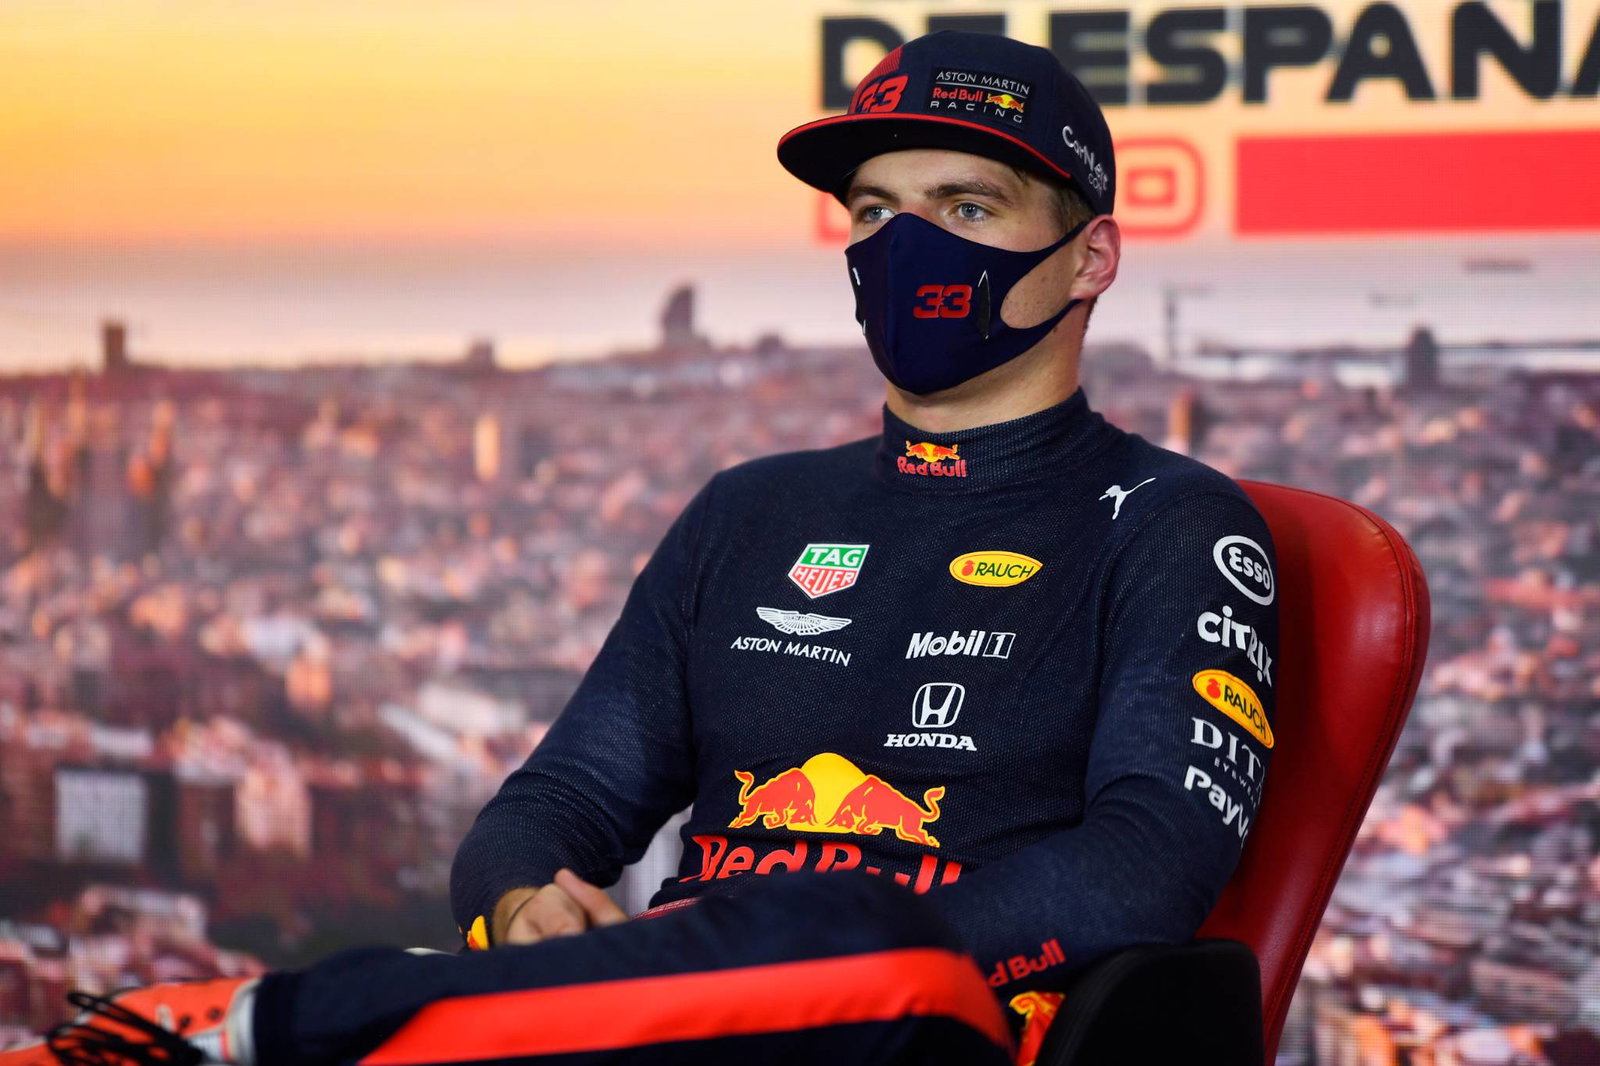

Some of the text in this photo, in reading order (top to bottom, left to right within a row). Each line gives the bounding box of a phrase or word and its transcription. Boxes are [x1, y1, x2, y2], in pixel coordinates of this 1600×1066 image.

[932, 87, 984, 103] Red Bull
[936, 71, 1030, 95] ASTON MARTIN
[930, 100, 1023, 124] RACING
[913, 284, 972, 318] 33
[897, 455, 967, 478] Red Bull
[810, 547, 863, 568] TAG
[793, 567, 856, 597] HEUER
[974, 560, 1035, 580] RAUCH
[731, 636, 851, 667] ASTON MARTIN
[905, 630, 986, 660] Mobil
[1223, 684, 1267, 741] RAUCH
[883, 732, 977, 752] HONDA
[1007, 938, 1067, 981] Bull
